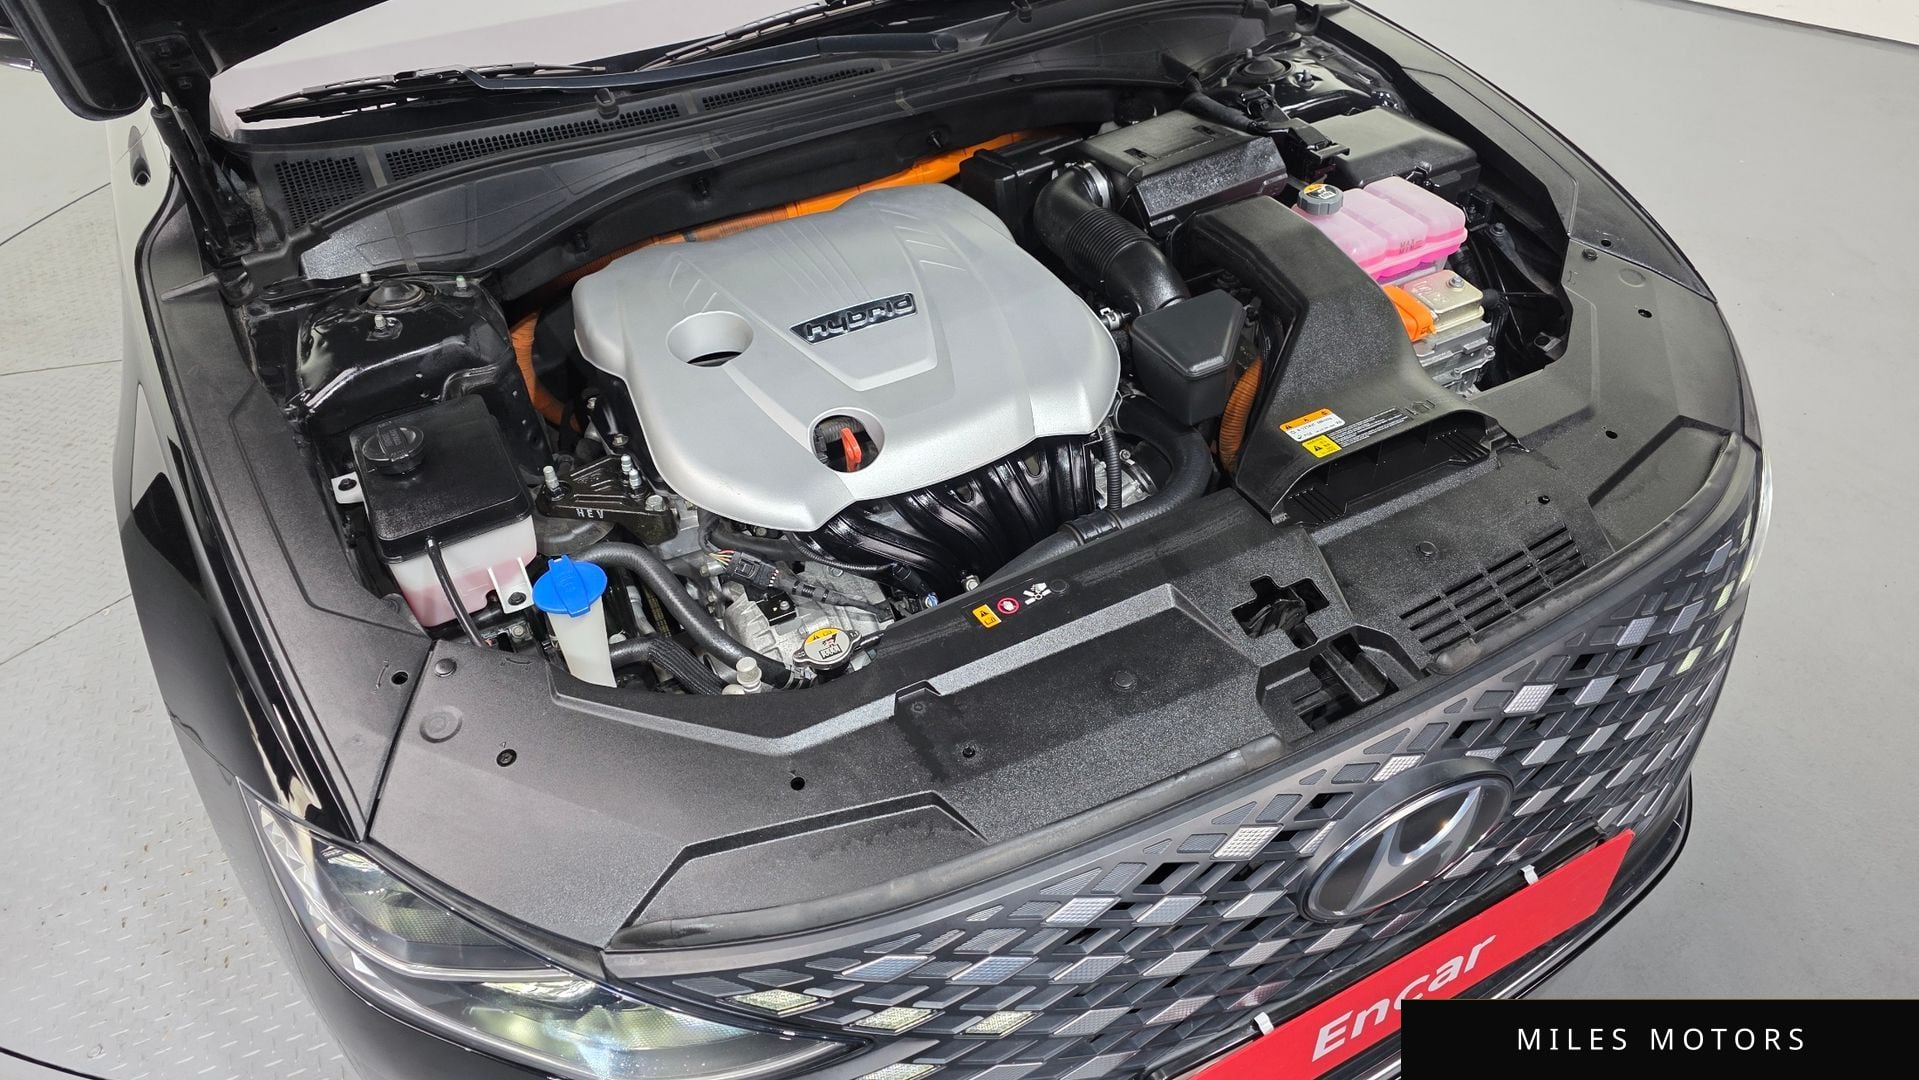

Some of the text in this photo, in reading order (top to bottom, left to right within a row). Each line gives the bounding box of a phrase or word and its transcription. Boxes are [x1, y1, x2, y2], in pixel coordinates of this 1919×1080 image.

[806, 294, 914, 340] hybrid
[576, 508, 604, 518] HEV
[1312, 934, 1497, 1062] Encar
